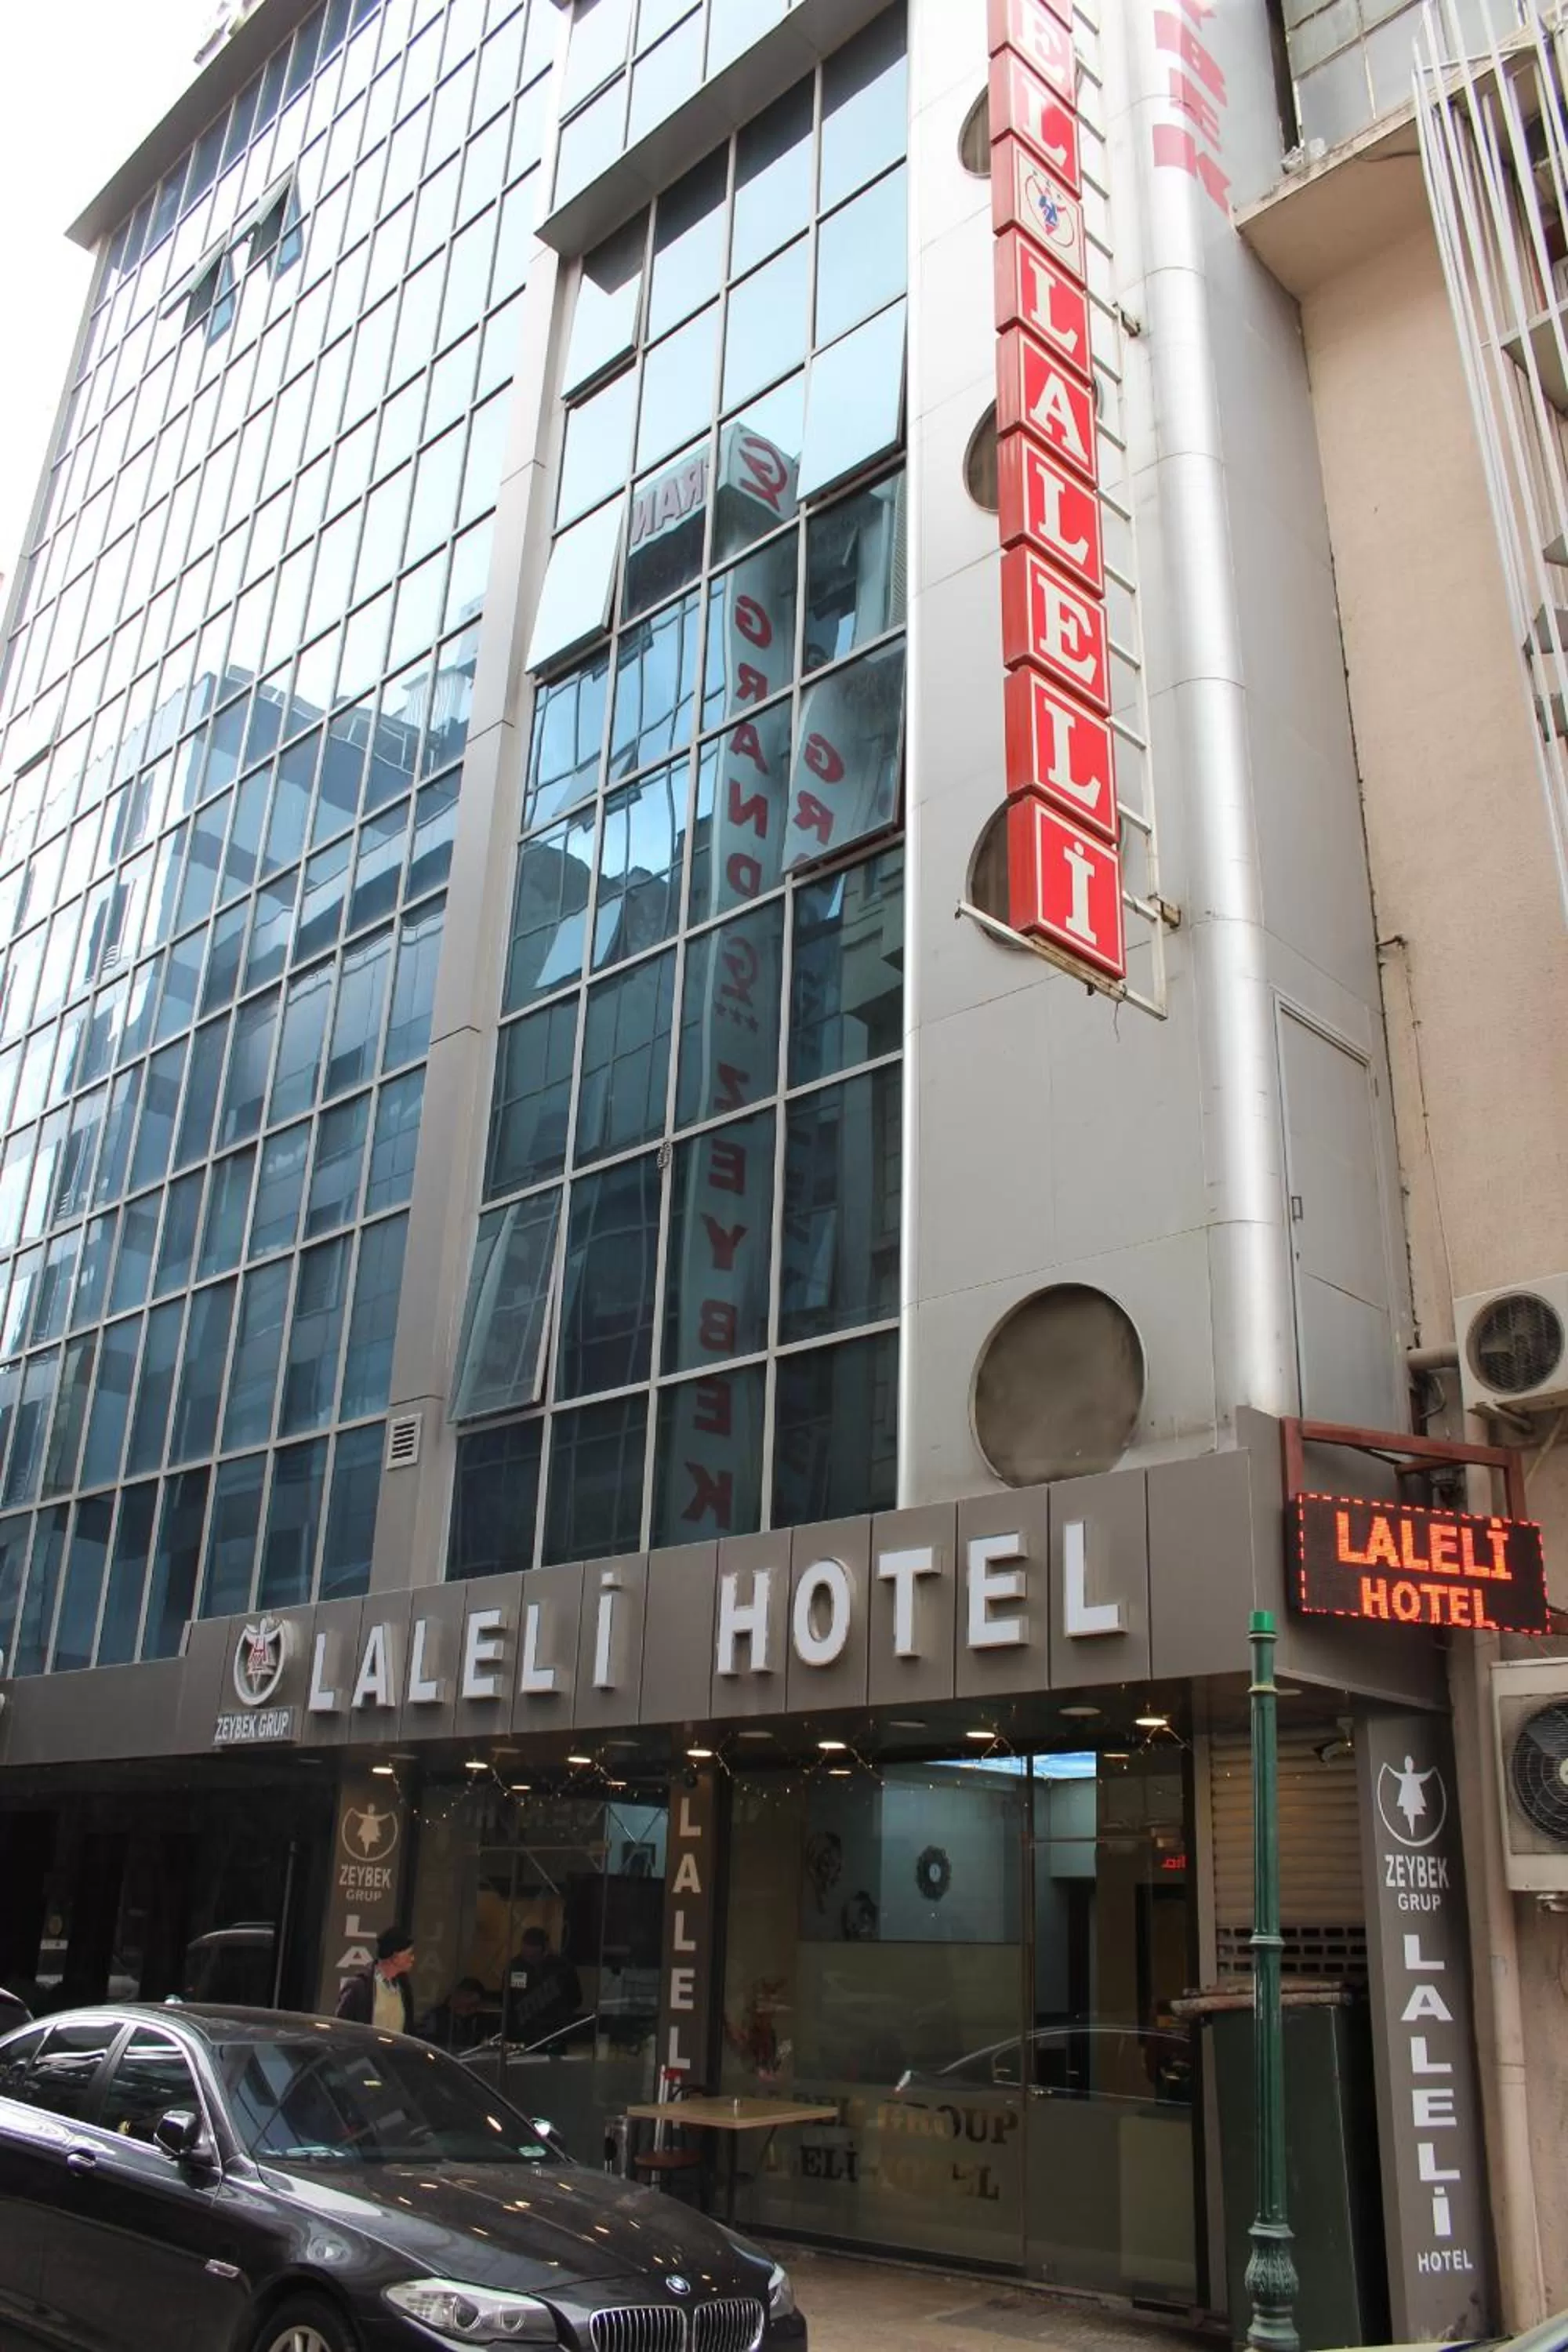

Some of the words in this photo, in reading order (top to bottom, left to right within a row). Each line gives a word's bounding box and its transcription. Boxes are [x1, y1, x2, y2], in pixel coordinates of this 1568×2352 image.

[1028, 257, 1102, 946] LALELİ
[1336, 1511, 1512, 1581] LALELİ
[308, 1571, 618, 1711] LALELİ
[715, 1520, 1128, 1675] HOTEL
[1361, 1577, 1497, 1628] HOTEL
[215, 1715, 256, 1740] ZEYBEK
[258, 1712, 289, 1737] GRUP
[339, 1863, 391, 1890] ZEYBEK
[1384, 1854, 1450, 1889] ZEYBEK
[346, 1889, 383, 1902] GRUP
[1398, 1893, 1442, 1911] GRUP
[1399, 1934, 1461, 2235] LALELİ
[1417, 2250, 1473, 2272] HOTEL
